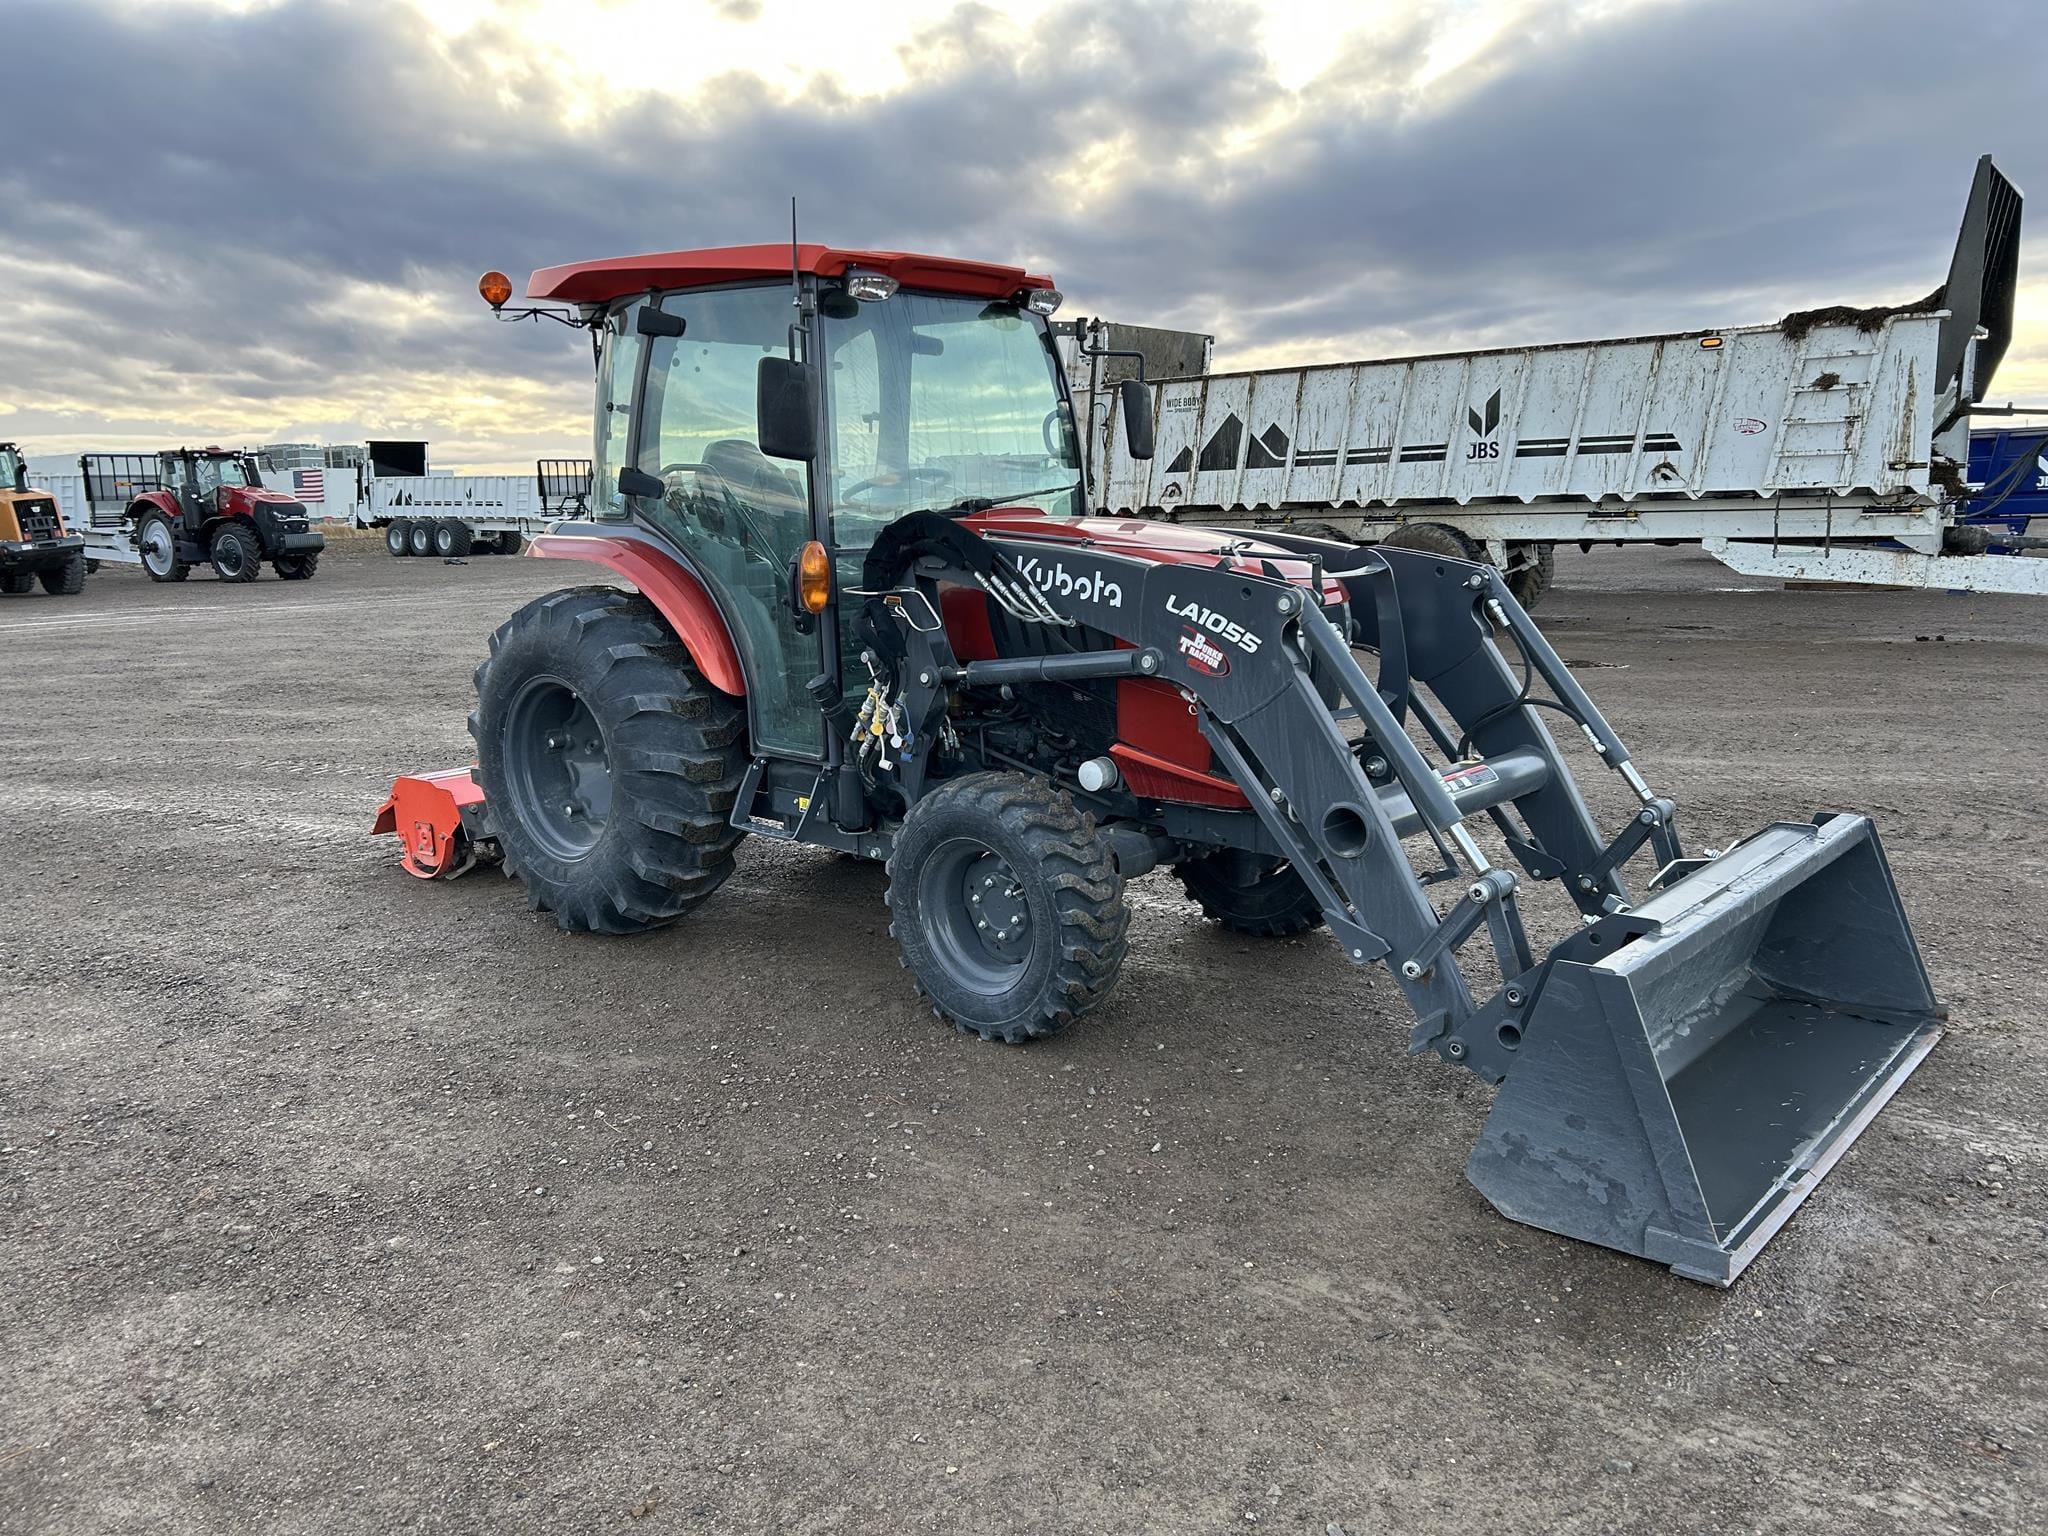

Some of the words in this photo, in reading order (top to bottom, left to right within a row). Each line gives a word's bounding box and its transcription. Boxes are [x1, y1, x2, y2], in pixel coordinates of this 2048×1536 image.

[1166, 398, 1182, 408] WIDE
[1466, 441, 1499, 459] JBS
[1017, 555, 1122, 607] Kubota
[1165, 594, 1263, 654] LA1055
[1180, 635, 1220, 669] TRACTOR
[1193, 632, 1224, 662] BURKS
